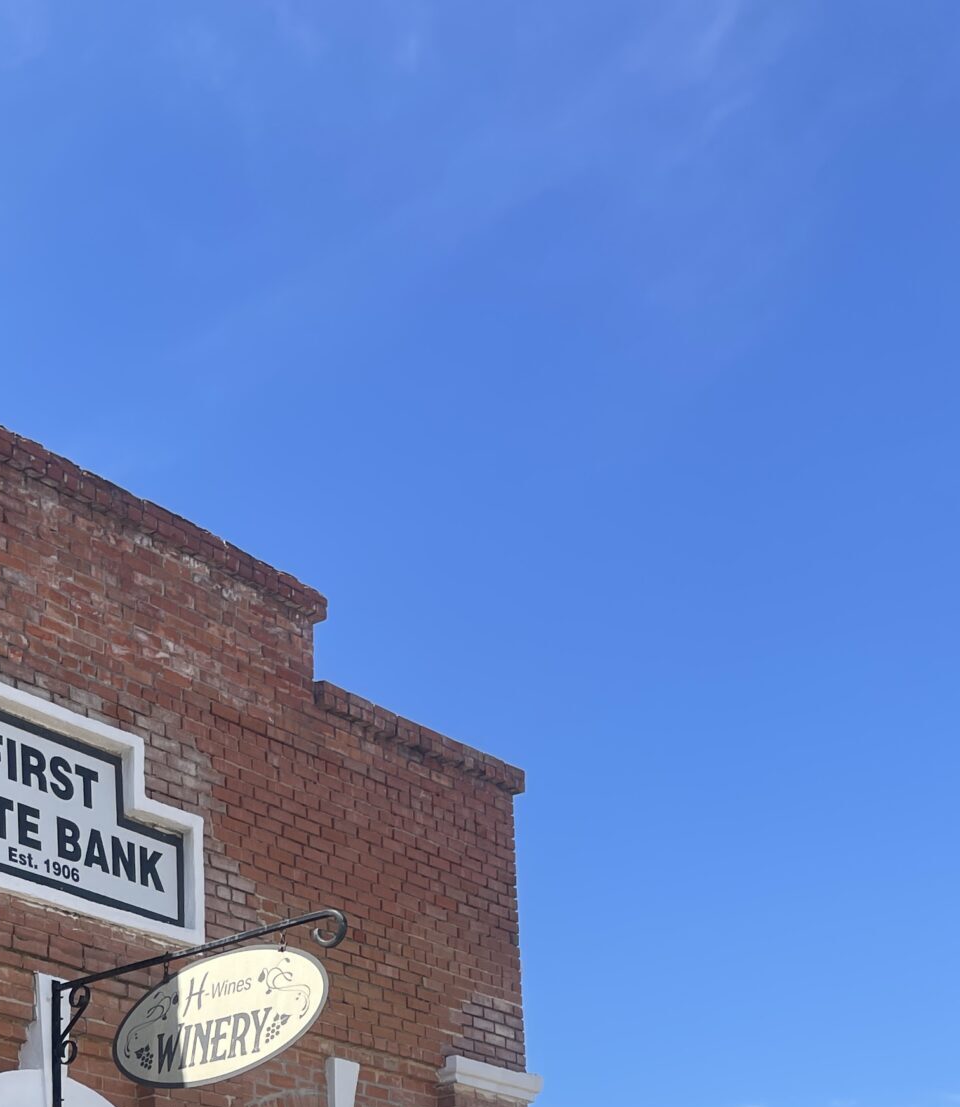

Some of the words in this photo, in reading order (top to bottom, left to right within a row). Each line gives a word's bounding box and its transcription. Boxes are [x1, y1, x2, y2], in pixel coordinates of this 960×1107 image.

[8, 846, 38, 870] Est.
[44, 858, 80, 883] 1906
[56, 816, 165, 893] BANK
[157, 1007, 272, 1074] WINERY
